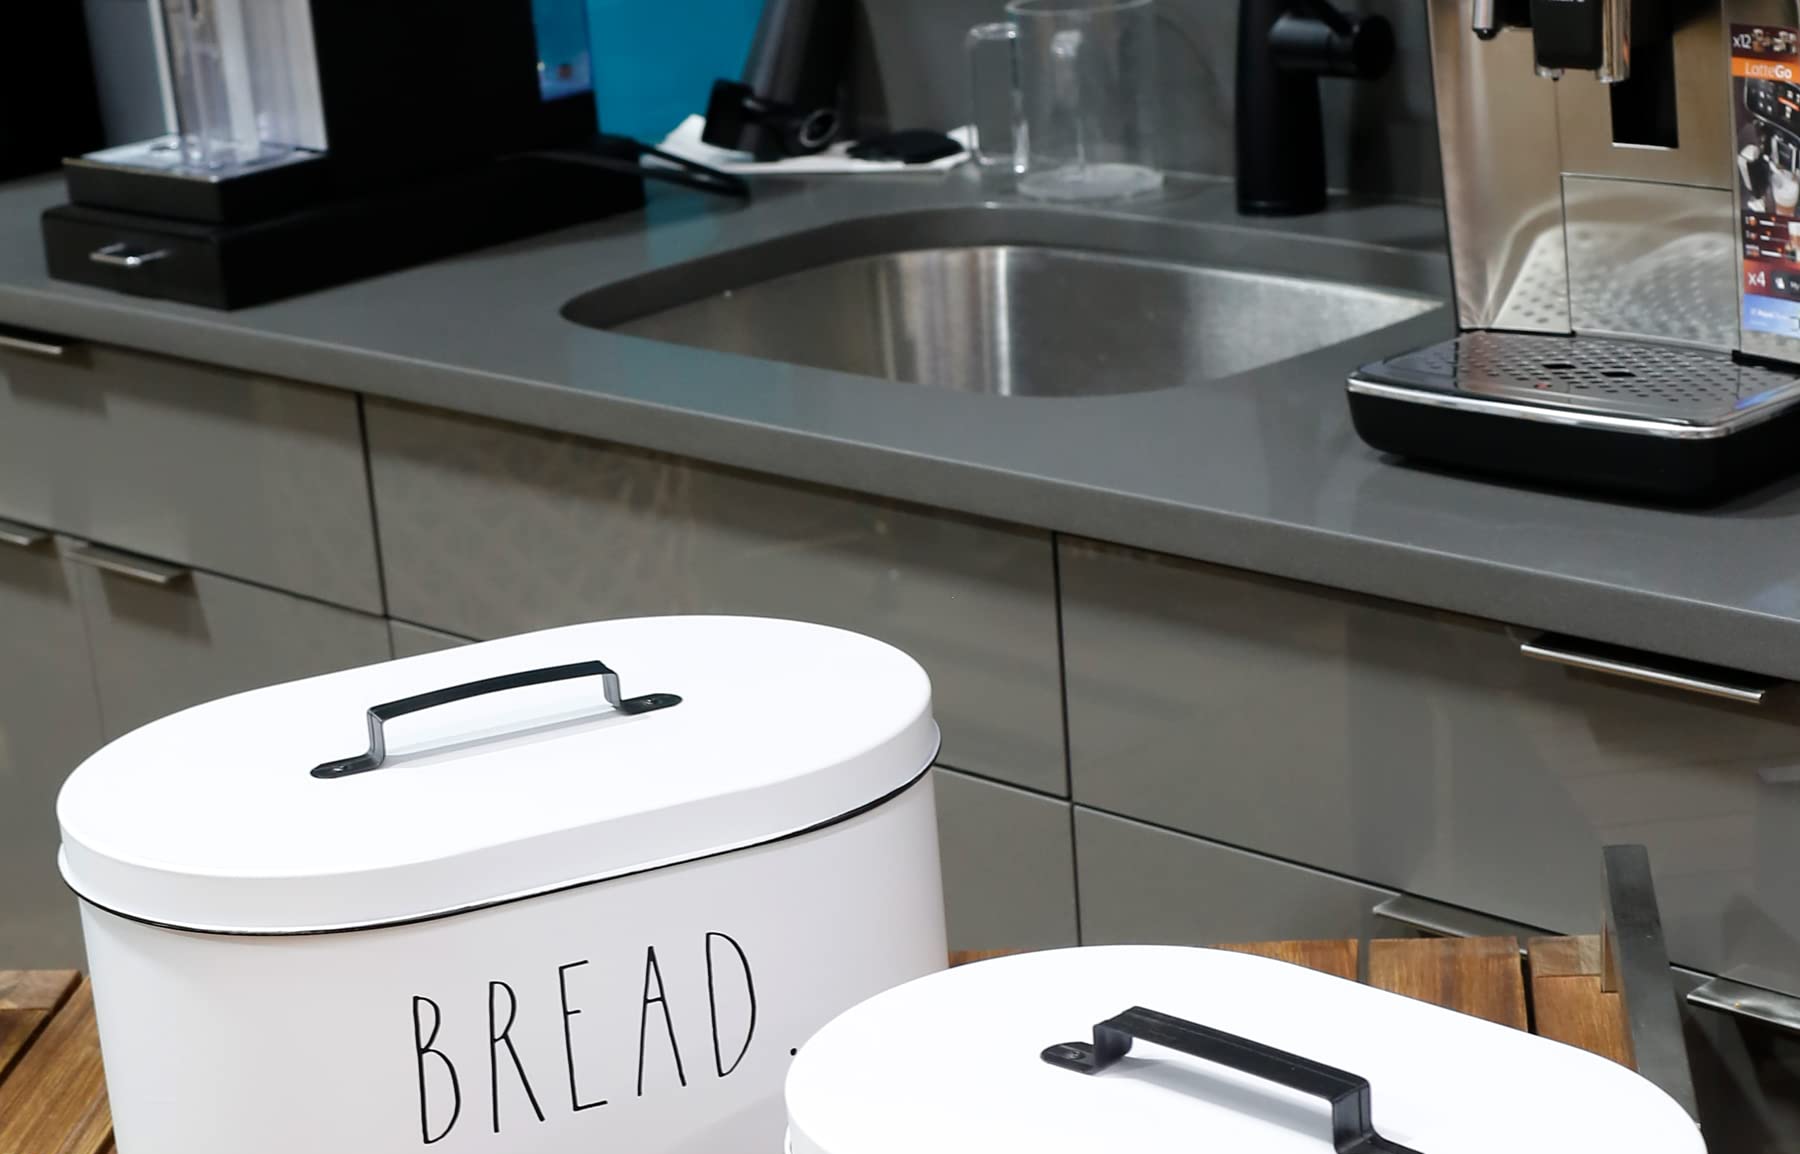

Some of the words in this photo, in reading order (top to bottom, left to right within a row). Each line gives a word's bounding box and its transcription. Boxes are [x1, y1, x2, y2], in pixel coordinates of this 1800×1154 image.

[1732, 33, 1752, 50] x12
[1744, 62, 1793, 80] LatteGo
[1747, 271, 1766, 288] x4
[412, 931, 798, 1145] BREAD.
